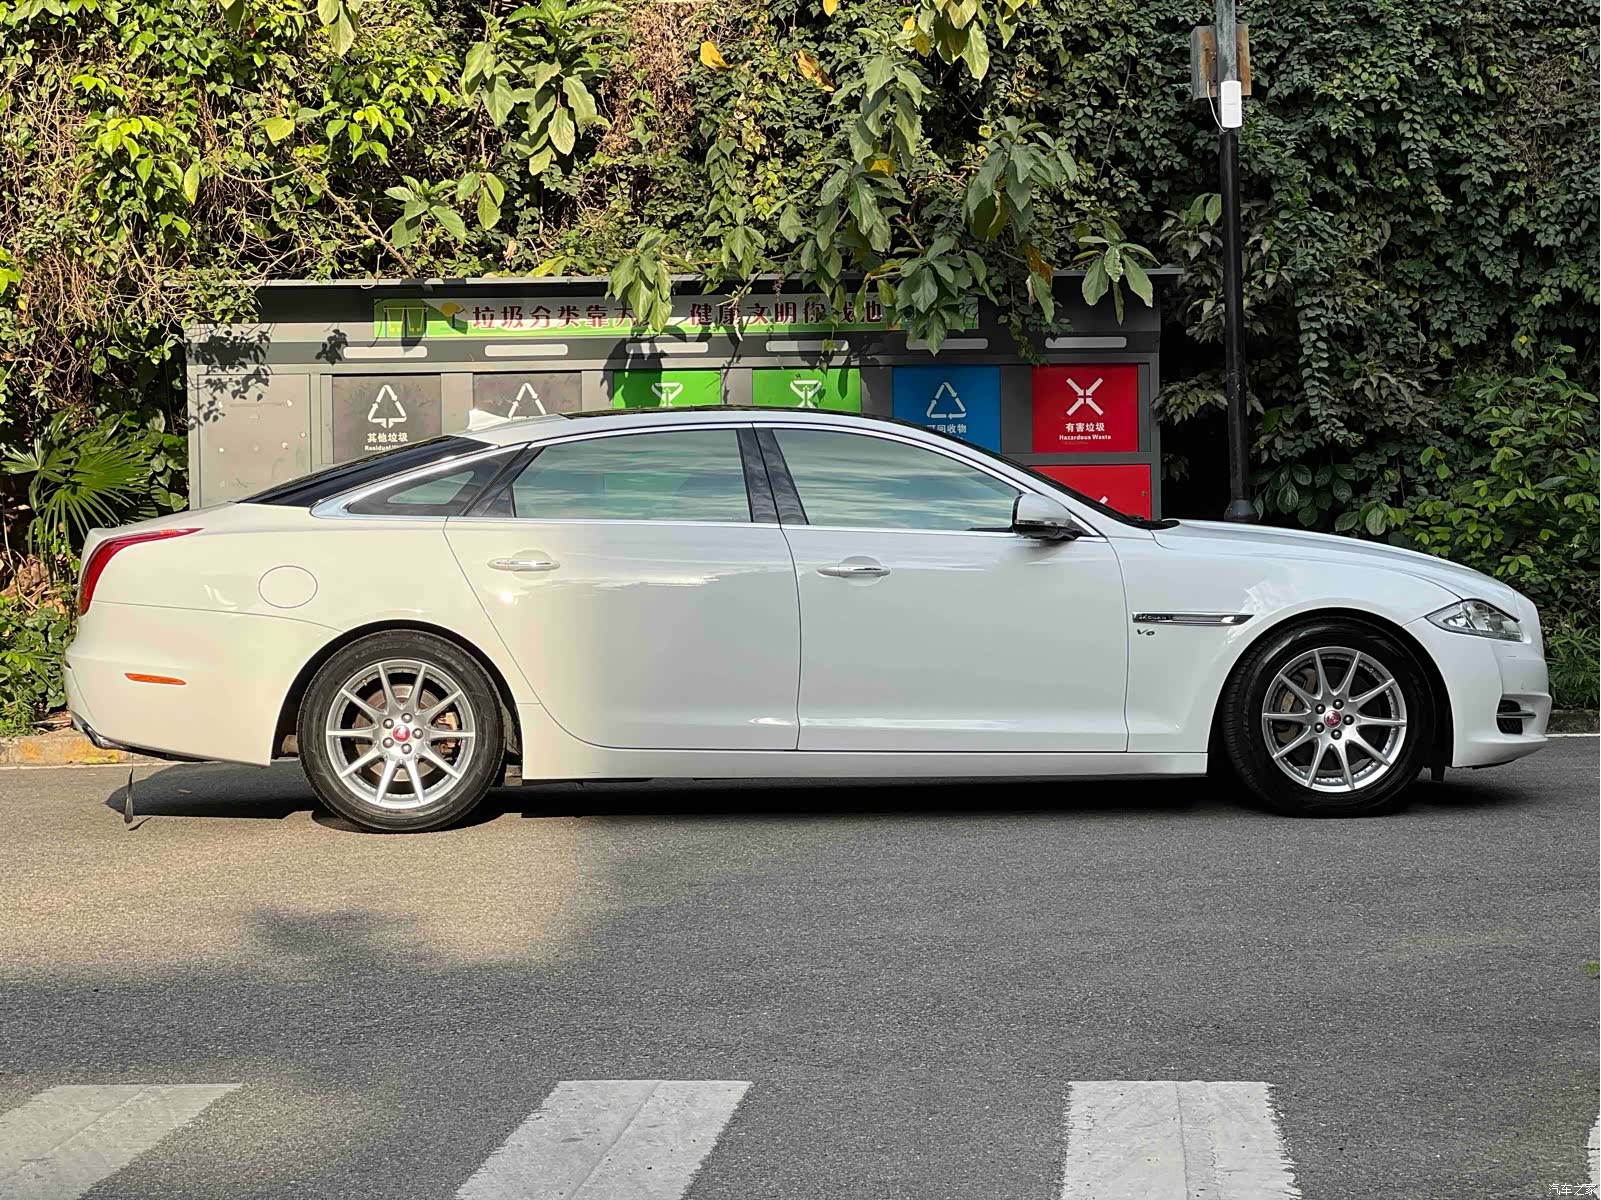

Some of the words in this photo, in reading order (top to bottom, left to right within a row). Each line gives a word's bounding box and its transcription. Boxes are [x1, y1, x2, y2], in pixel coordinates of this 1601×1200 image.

[473, 304, 657, 329] 垃圾分类靠大
[1065, 422, 1105, 432] 有害垃圾
[367, 432, 408, 443] 其他垃圾
